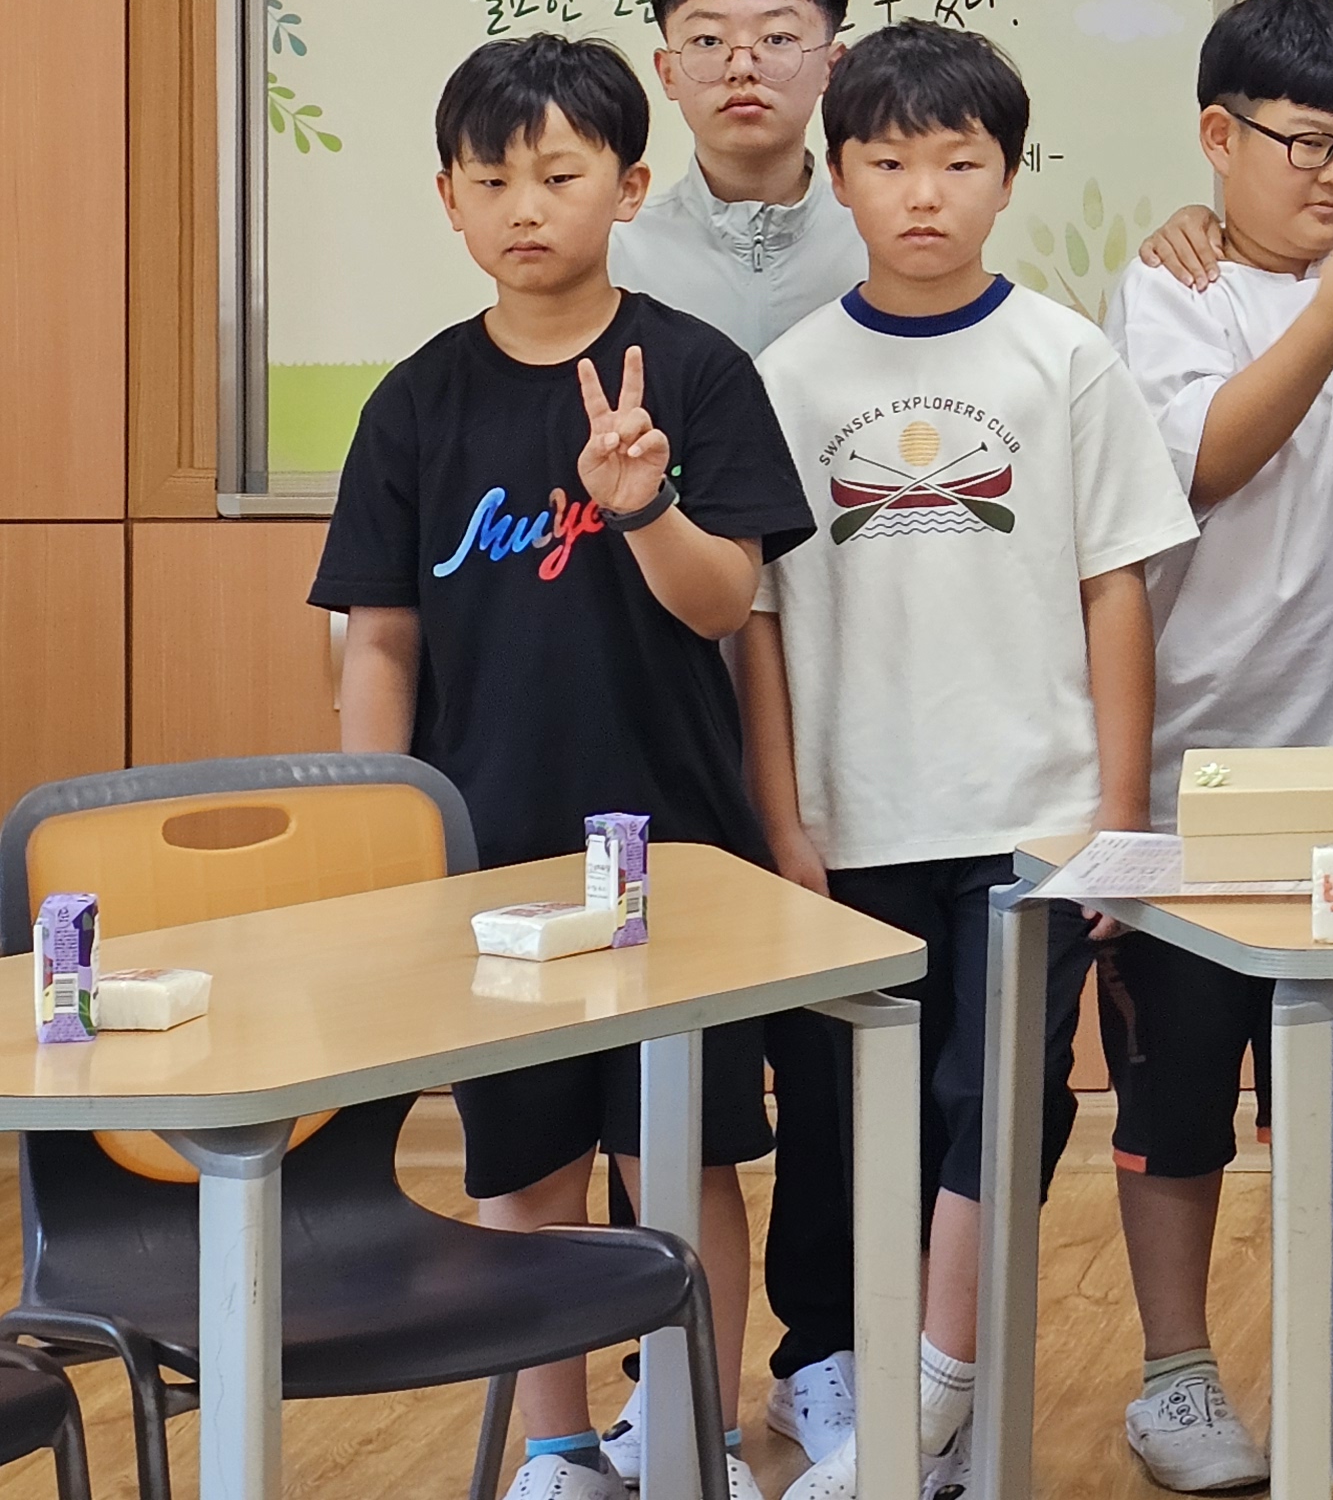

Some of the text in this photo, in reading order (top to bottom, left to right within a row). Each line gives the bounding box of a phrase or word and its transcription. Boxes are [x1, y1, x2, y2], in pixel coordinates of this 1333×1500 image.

[819, 396, 1022, 466] SWANSEA EXPLORERS CLUB
